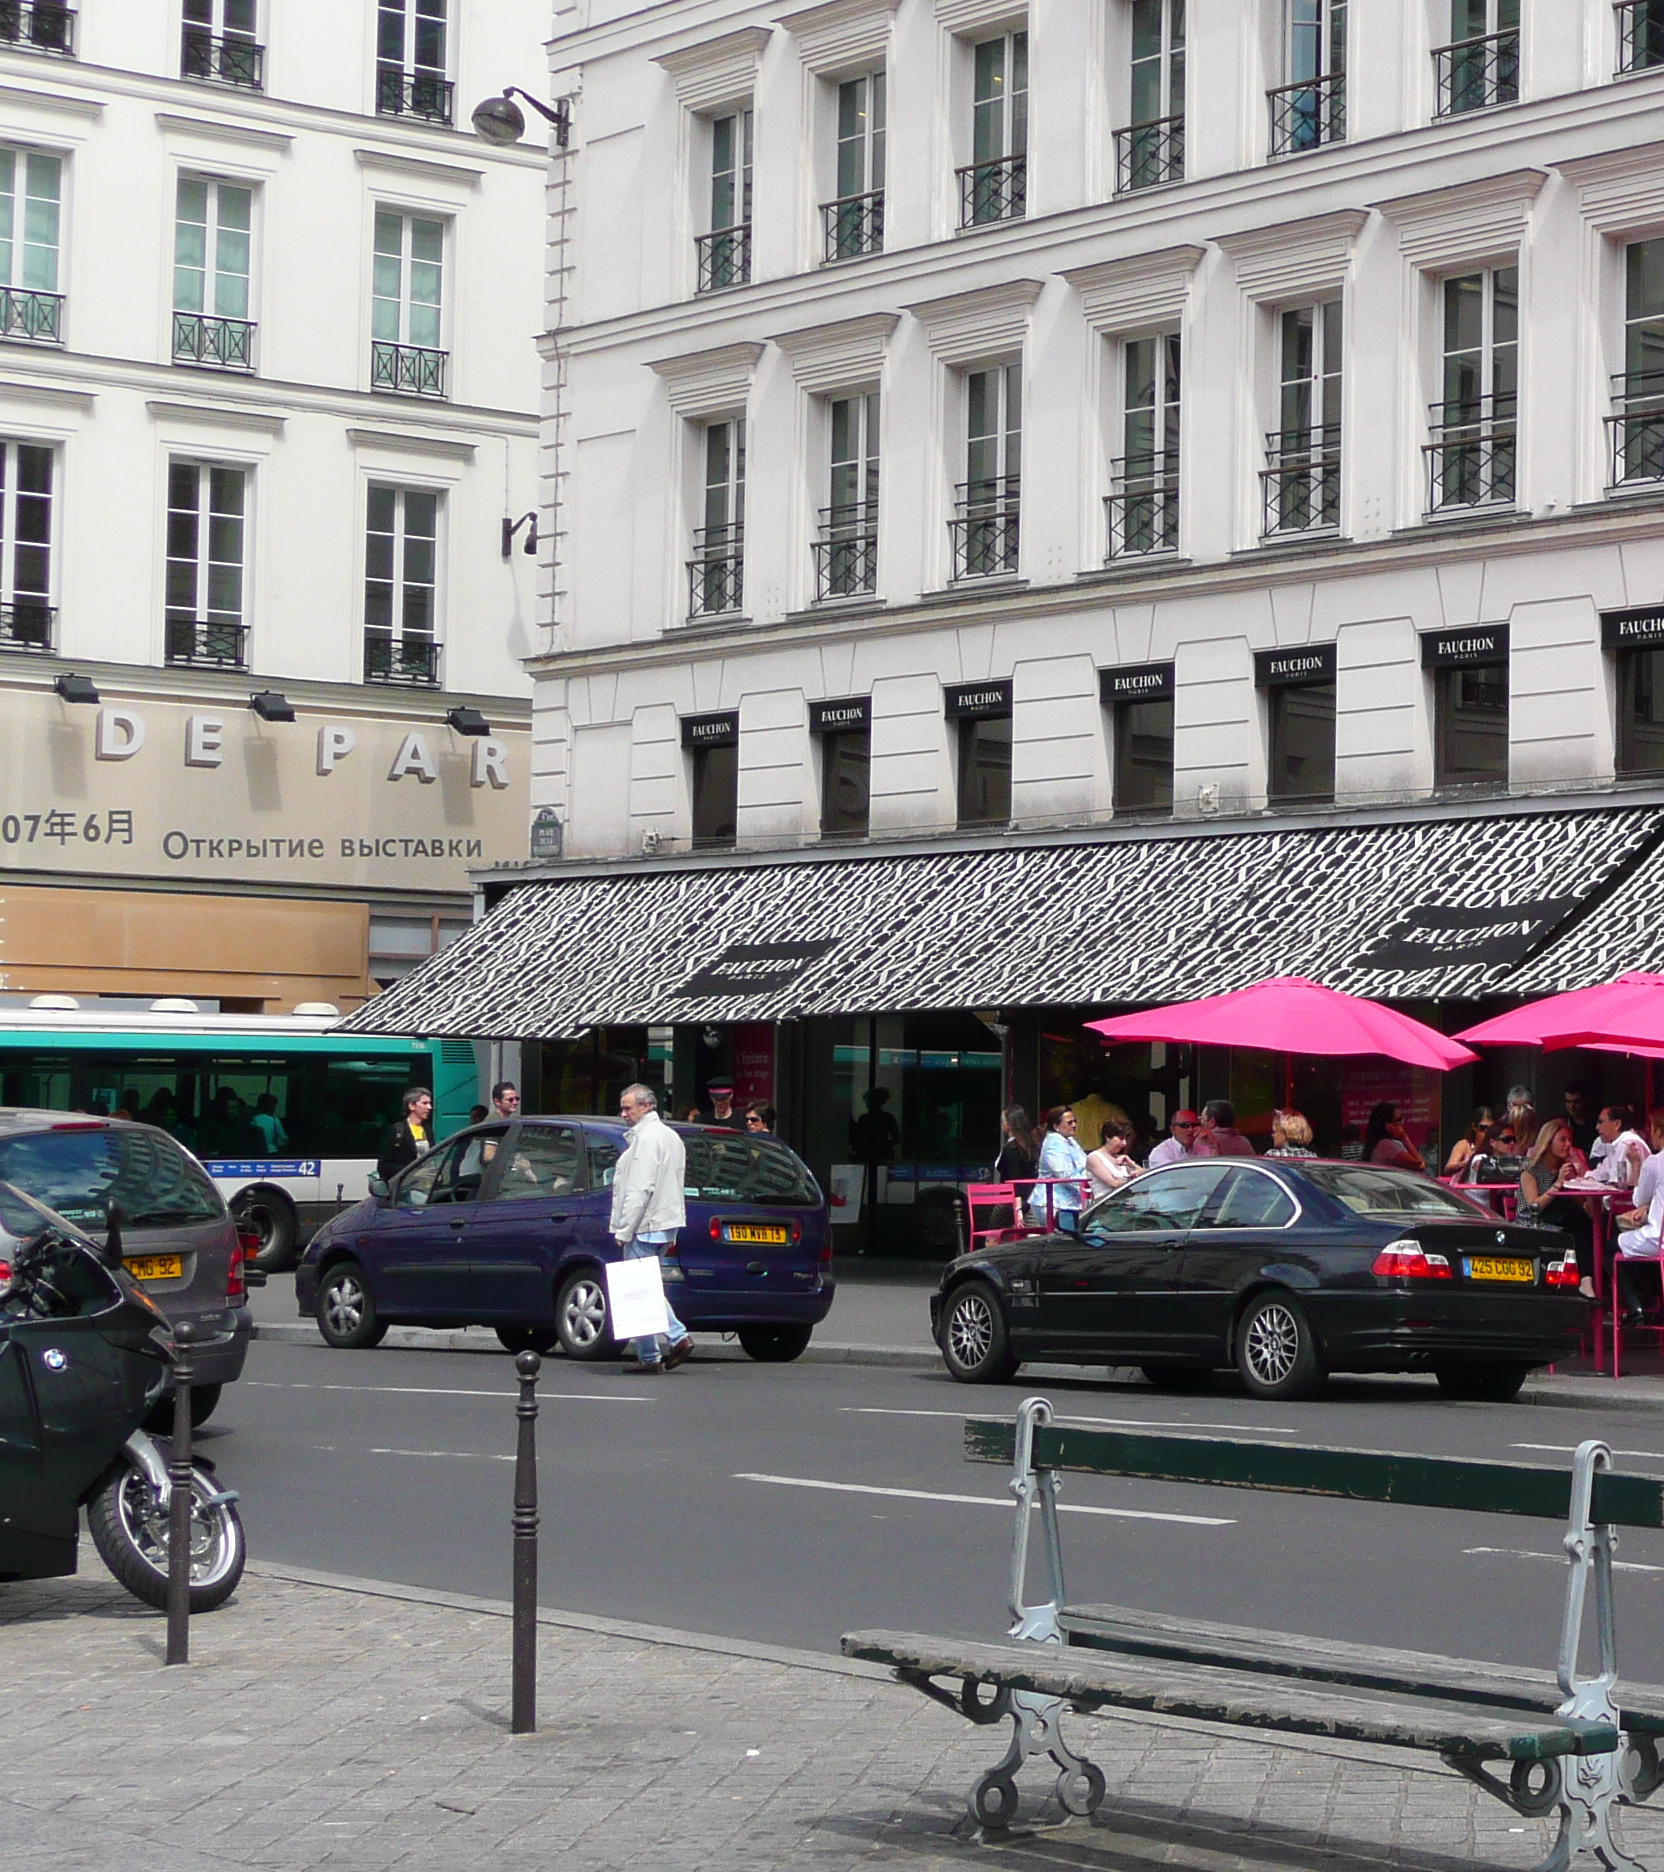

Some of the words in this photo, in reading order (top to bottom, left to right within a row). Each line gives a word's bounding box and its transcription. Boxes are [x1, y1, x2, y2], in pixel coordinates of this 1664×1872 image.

[1438, 637, 1494, 654] FAUCHON
[1270, 656, 1322, 673] FAUCHON
[1114, 674, 1162, 690] FAUCHON
[958, 691, 1002, 706] FAUCHON
[821, 707, 862, 721] FAUCHON
[692, 722, 731, 736] FAUCHON
[96, 708, 223, 767] DE
[317, 724, 509, 790] PAR
[163, 831, 324, 859] Открытие
[341, 837, 482, 858] выставки
[1402, 919, 1543, 944] FAUCHON
[710, 956, 812, 976] FAUCHON
[299, 1161, 316, 1176] 42
[730, 1225, 748, 1239] 190
[129, 1257, 154, 1276] CMG
[159, 1256, 175, 1275] 92
[1472, 1259, 1493, 1274] 425
[1520, 1260, 1532, 1277] 92
